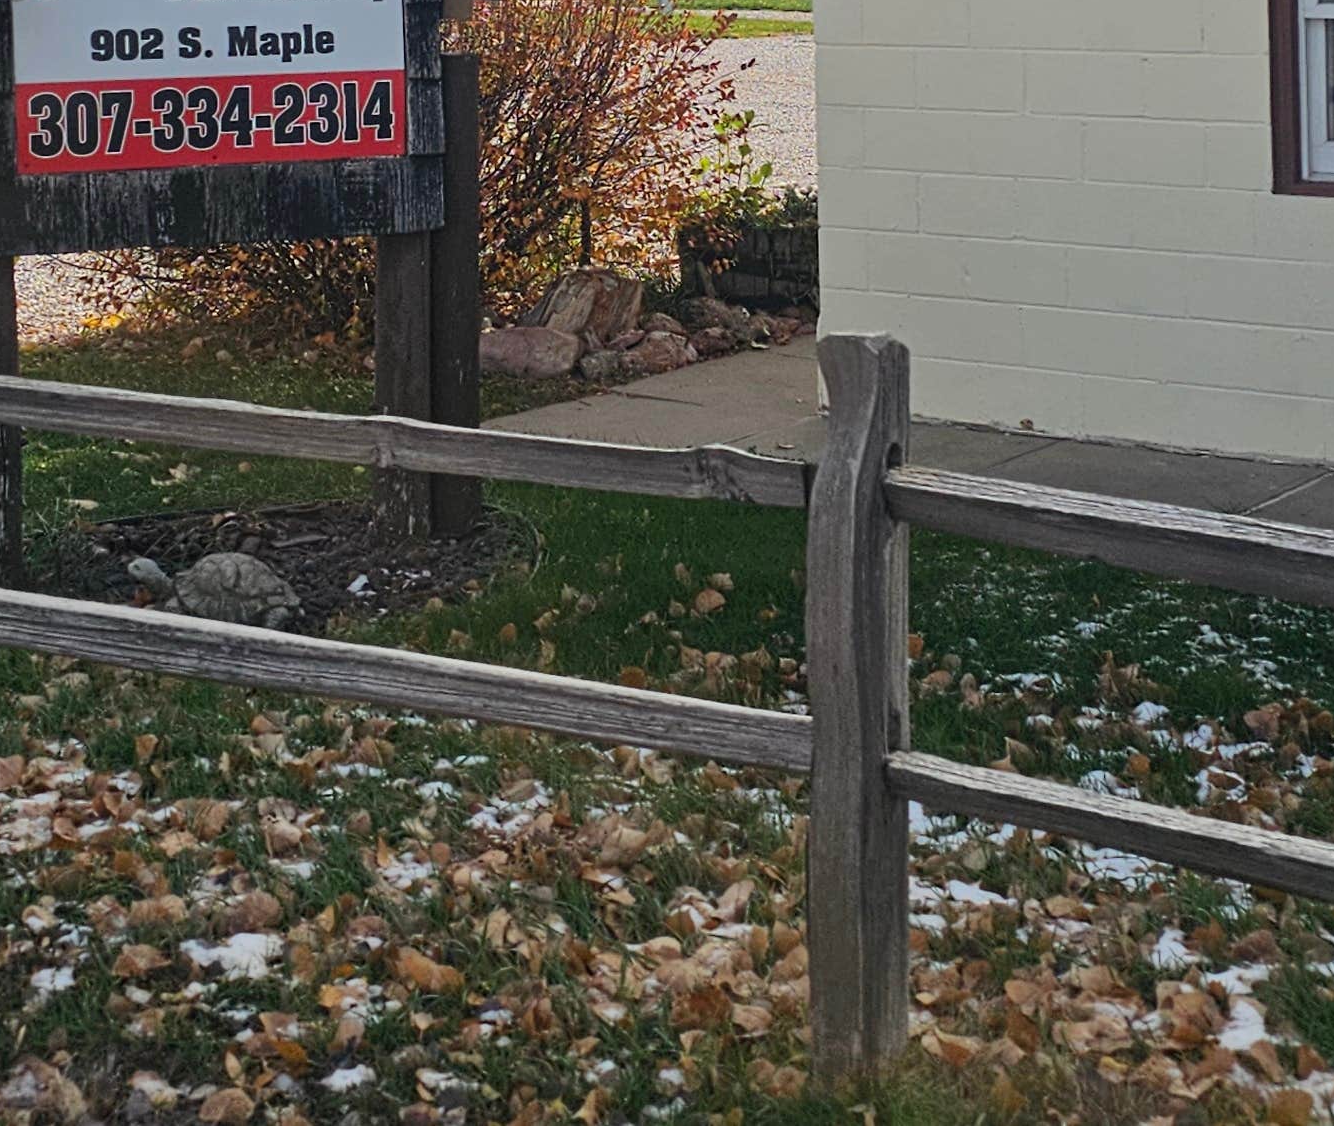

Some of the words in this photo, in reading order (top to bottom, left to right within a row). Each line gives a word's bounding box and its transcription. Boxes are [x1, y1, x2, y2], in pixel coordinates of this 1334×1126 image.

[90, 28, 164, 61] 902
[178, 27, 213, 58] S.
[227, 24, 335, 62] Maple
[29, 80, 394, 158] 307-334-2314
